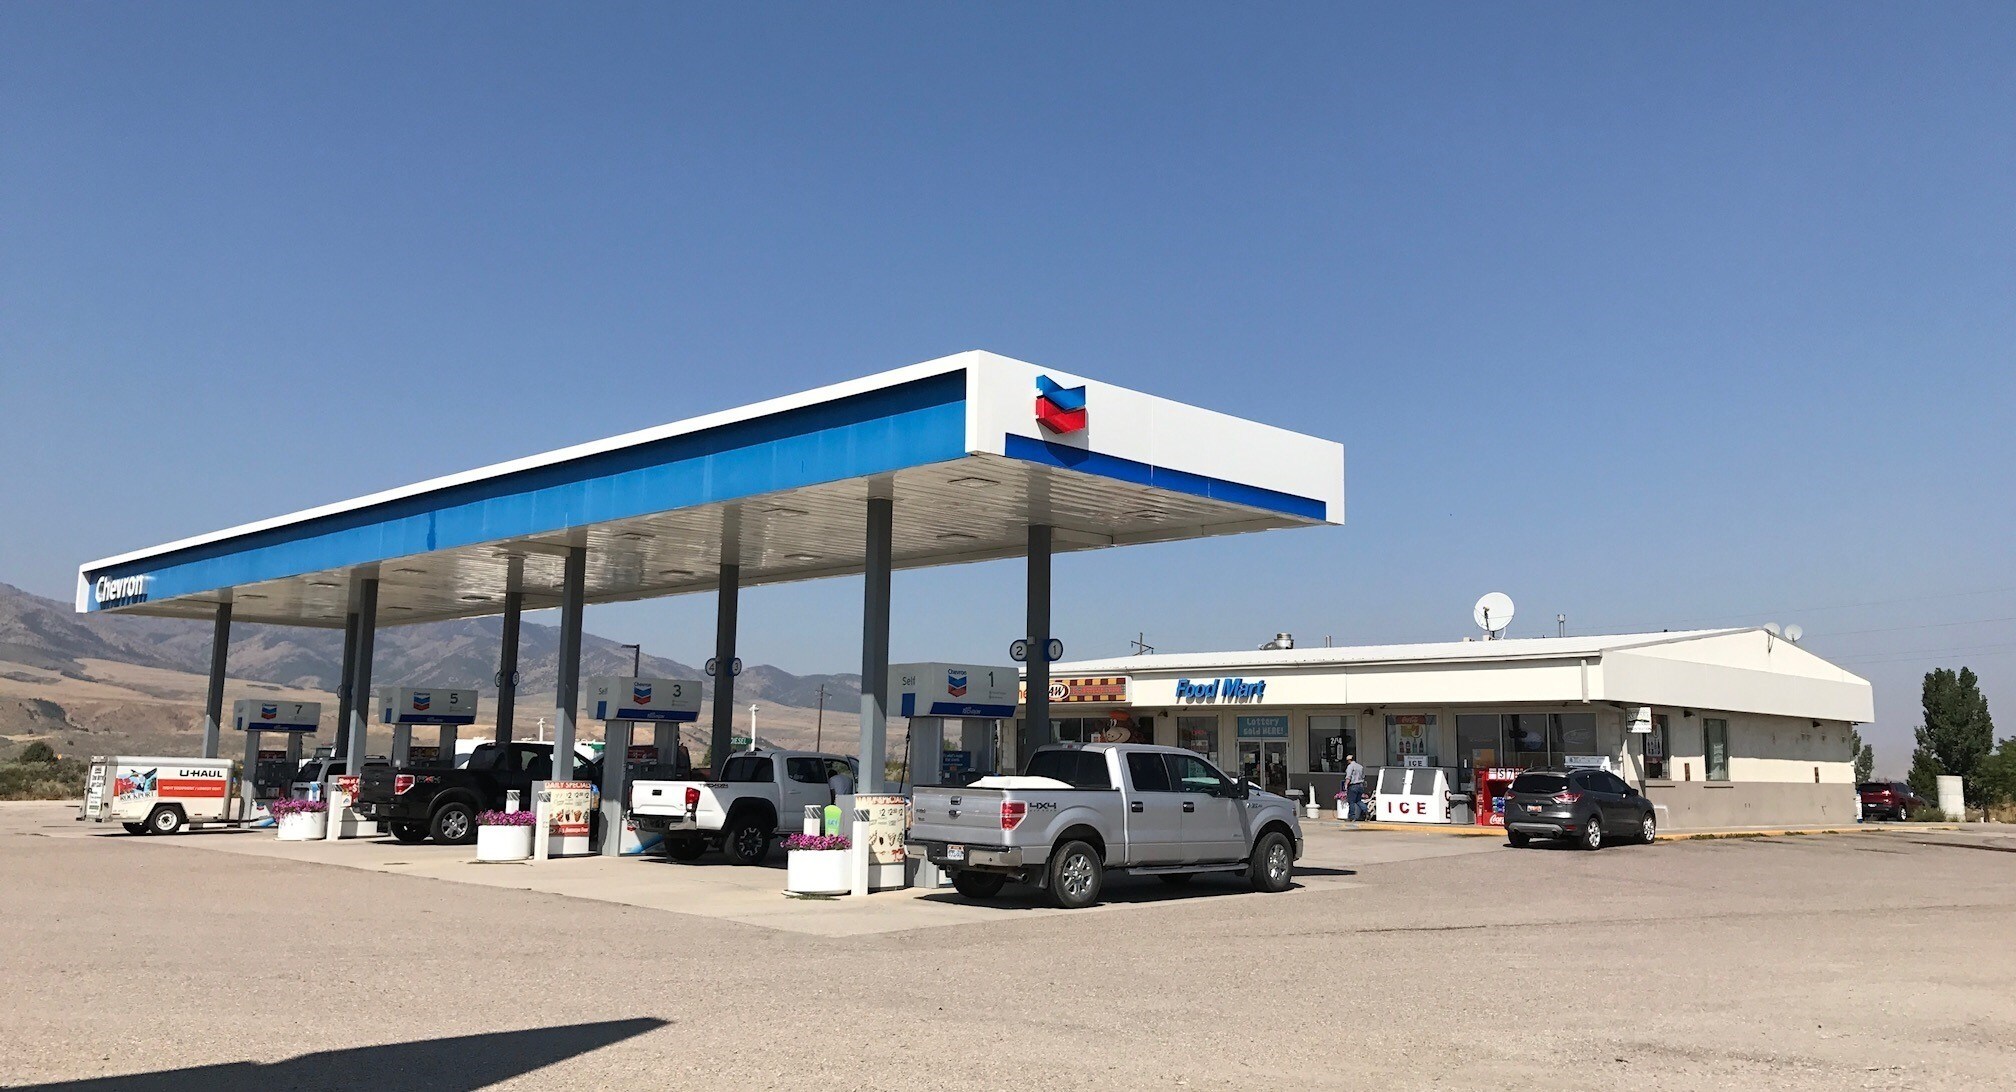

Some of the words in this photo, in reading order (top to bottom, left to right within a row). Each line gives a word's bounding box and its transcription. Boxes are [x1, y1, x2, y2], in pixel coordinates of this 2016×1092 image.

[95, 574, 144, 603] Chevron
[1016, 646, 1023, 656] 2
[708, 662, 715, 672] 4
[734, 662, 739, 672] 3
[947, 668, 967, 676] Chevron
[902, 676, 916, 686] Self
[988, 671, 994, 688] 1
[672, 684, 682, 698] 3
[1176, 678, 1219, 698] Food
[1221, 679, 1267, 698] Mart
[449, 693, 459, 704] 5
[294, 704, 303, 714] 7
[1246, 718, 1280, 727] Lottery
[1262, 727, 1284, 735] HERE!
[180, 769, 223, 778] U-HAUL
[1388, 802, 1427, 814] ICE
